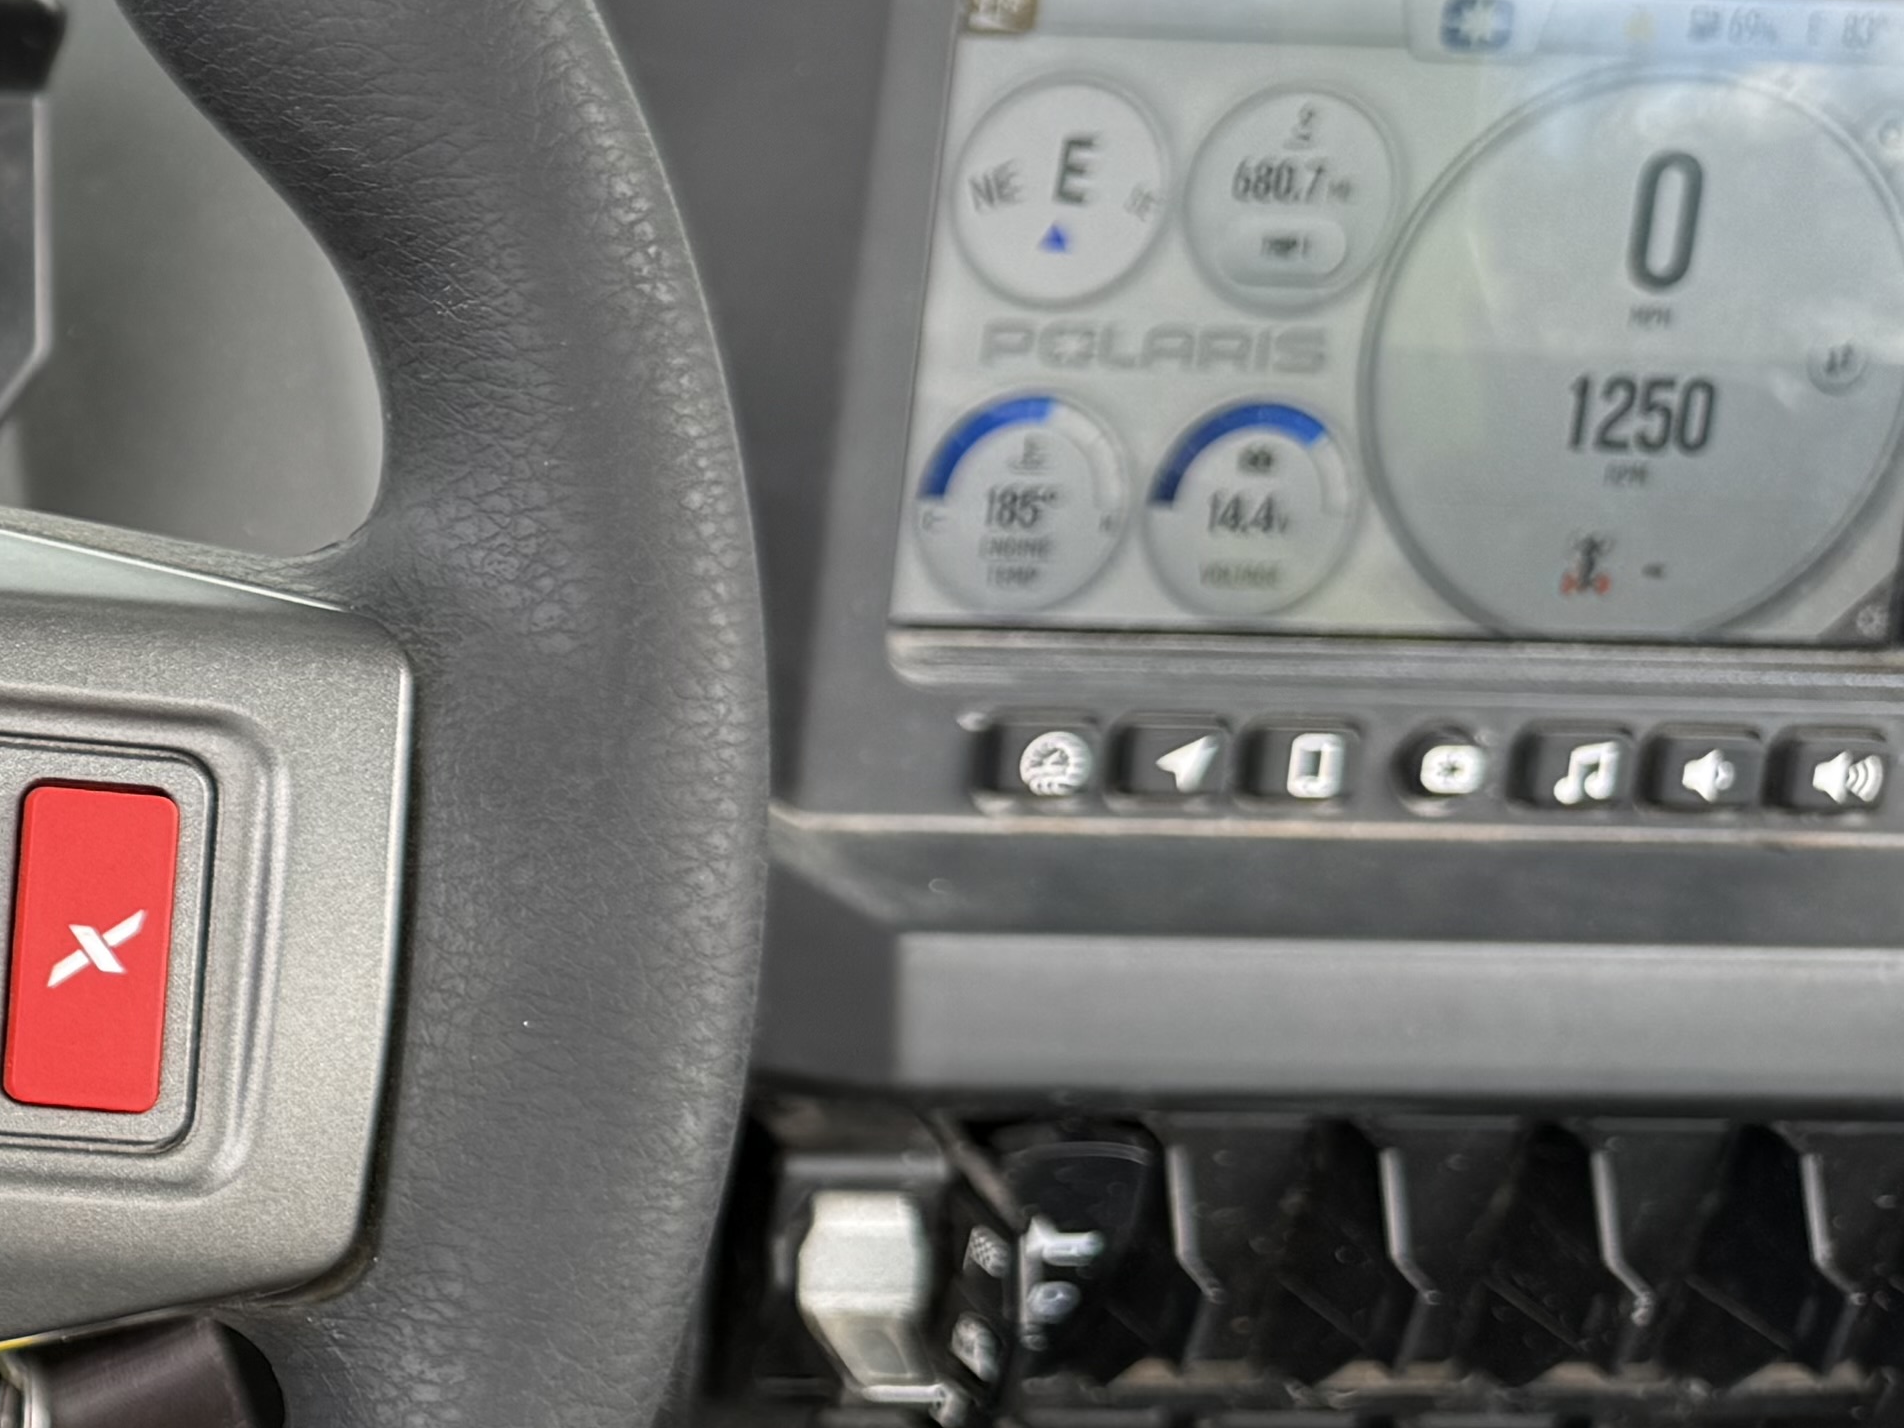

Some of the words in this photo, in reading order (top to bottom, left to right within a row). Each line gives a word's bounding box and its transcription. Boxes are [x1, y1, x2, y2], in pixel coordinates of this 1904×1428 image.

[968, 160, 1025, 213] NE
[1052, 130, 1104, 208] E
[1230, 155, 1330, 204] 680.7
[1625, 148, 1706, 293] 0
[977, 318, 1330, 374] POLARIS
[1564, 370, 1720, 459] 1250
[977, 534, 1056, 561] ENGINE
